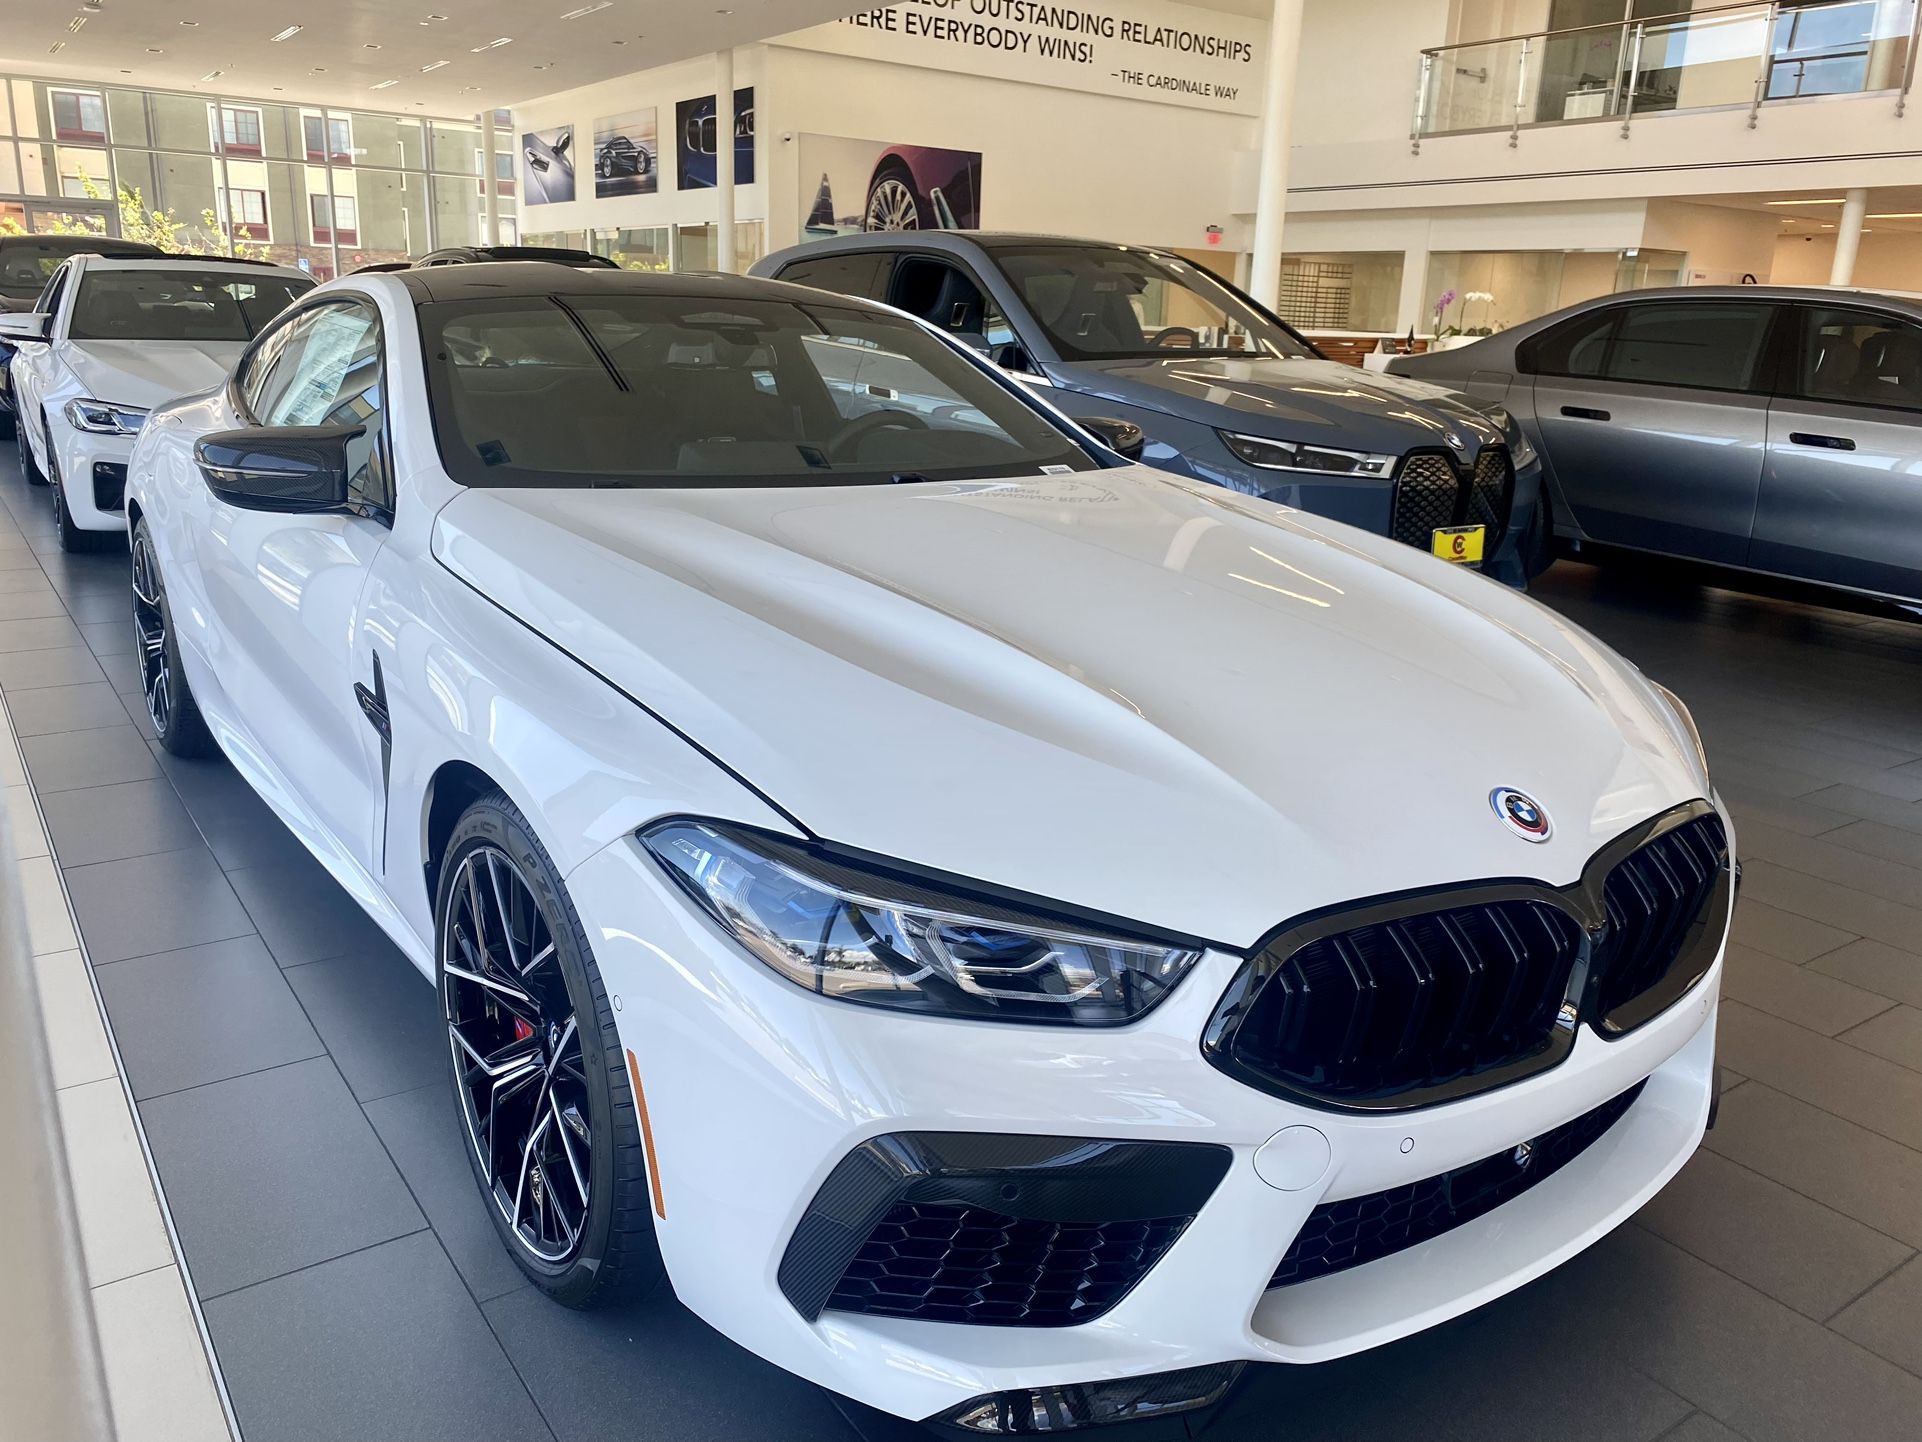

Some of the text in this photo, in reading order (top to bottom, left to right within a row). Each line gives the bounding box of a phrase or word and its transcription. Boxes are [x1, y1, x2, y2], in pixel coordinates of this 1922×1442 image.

[905, 12, 1032, 53] EVERYBODY
[1038, 35, 1094, 64] WINS!
[970, 0, 1252, 62] OUTSTANDING RELATIONSHIPS
[1147, 74, 1211, 96] CARDINALE
[1214, 85, 1239, 101] WAY
